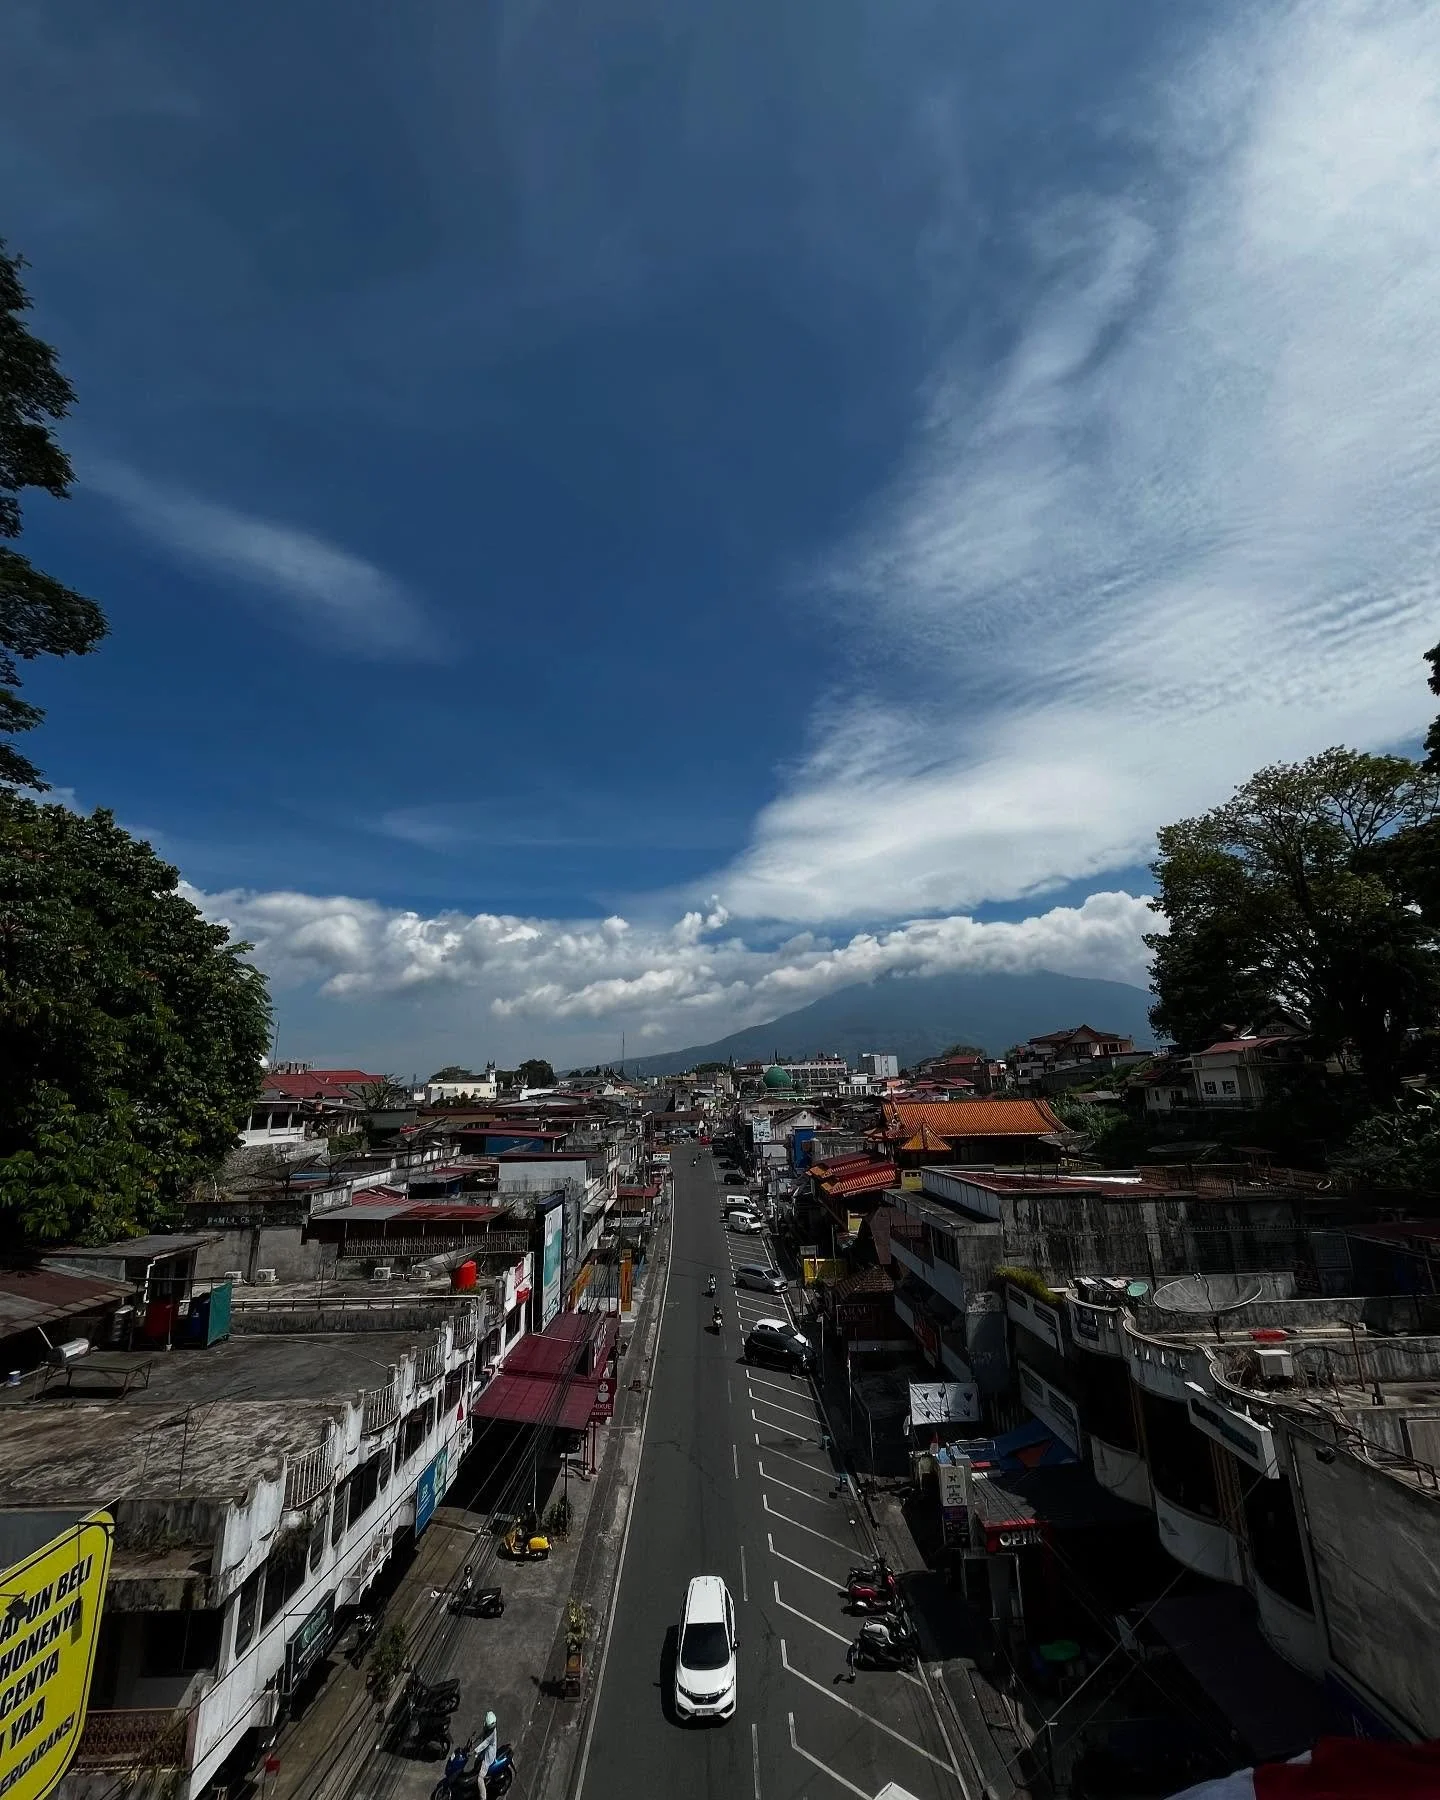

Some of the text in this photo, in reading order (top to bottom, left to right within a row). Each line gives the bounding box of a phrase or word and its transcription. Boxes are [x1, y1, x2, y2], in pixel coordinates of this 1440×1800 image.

[1000, 1528, 1042, 1547] OPTIK
[55, 1553, 94, 1603] BELI
[0, 1596, 83, 1681] HONENYA
[0, 1648, 60, 1720] CENYA
[10, 1696, 46, 1751] YAA
